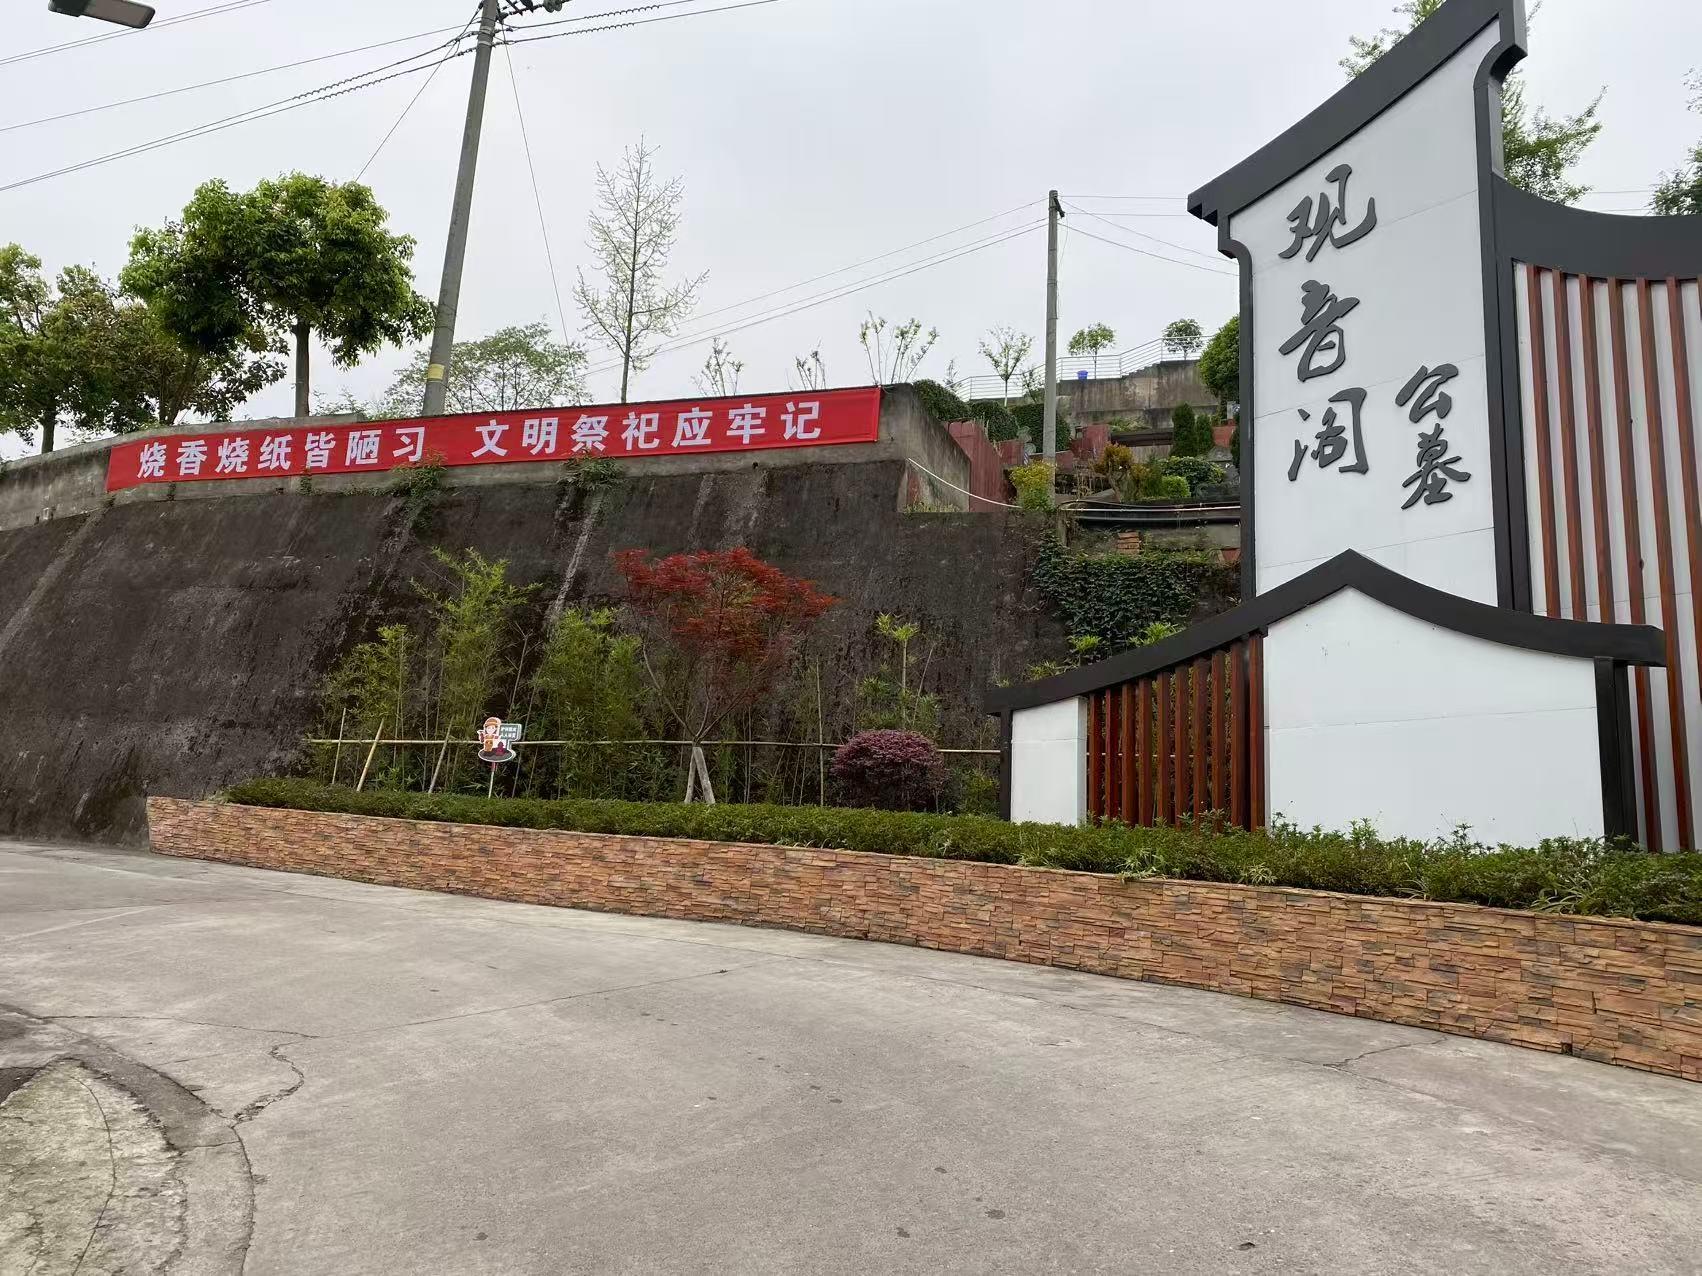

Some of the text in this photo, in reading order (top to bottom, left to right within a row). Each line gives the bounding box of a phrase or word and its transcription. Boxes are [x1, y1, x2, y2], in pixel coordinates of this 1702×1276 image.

[1279, 163, 1377, 482] 观音阁
[137, 401, 822, 479] 烧香烧纸皆陋习 文明祭祀应牢记
[1395, 363, 1472, 510] 公墓
